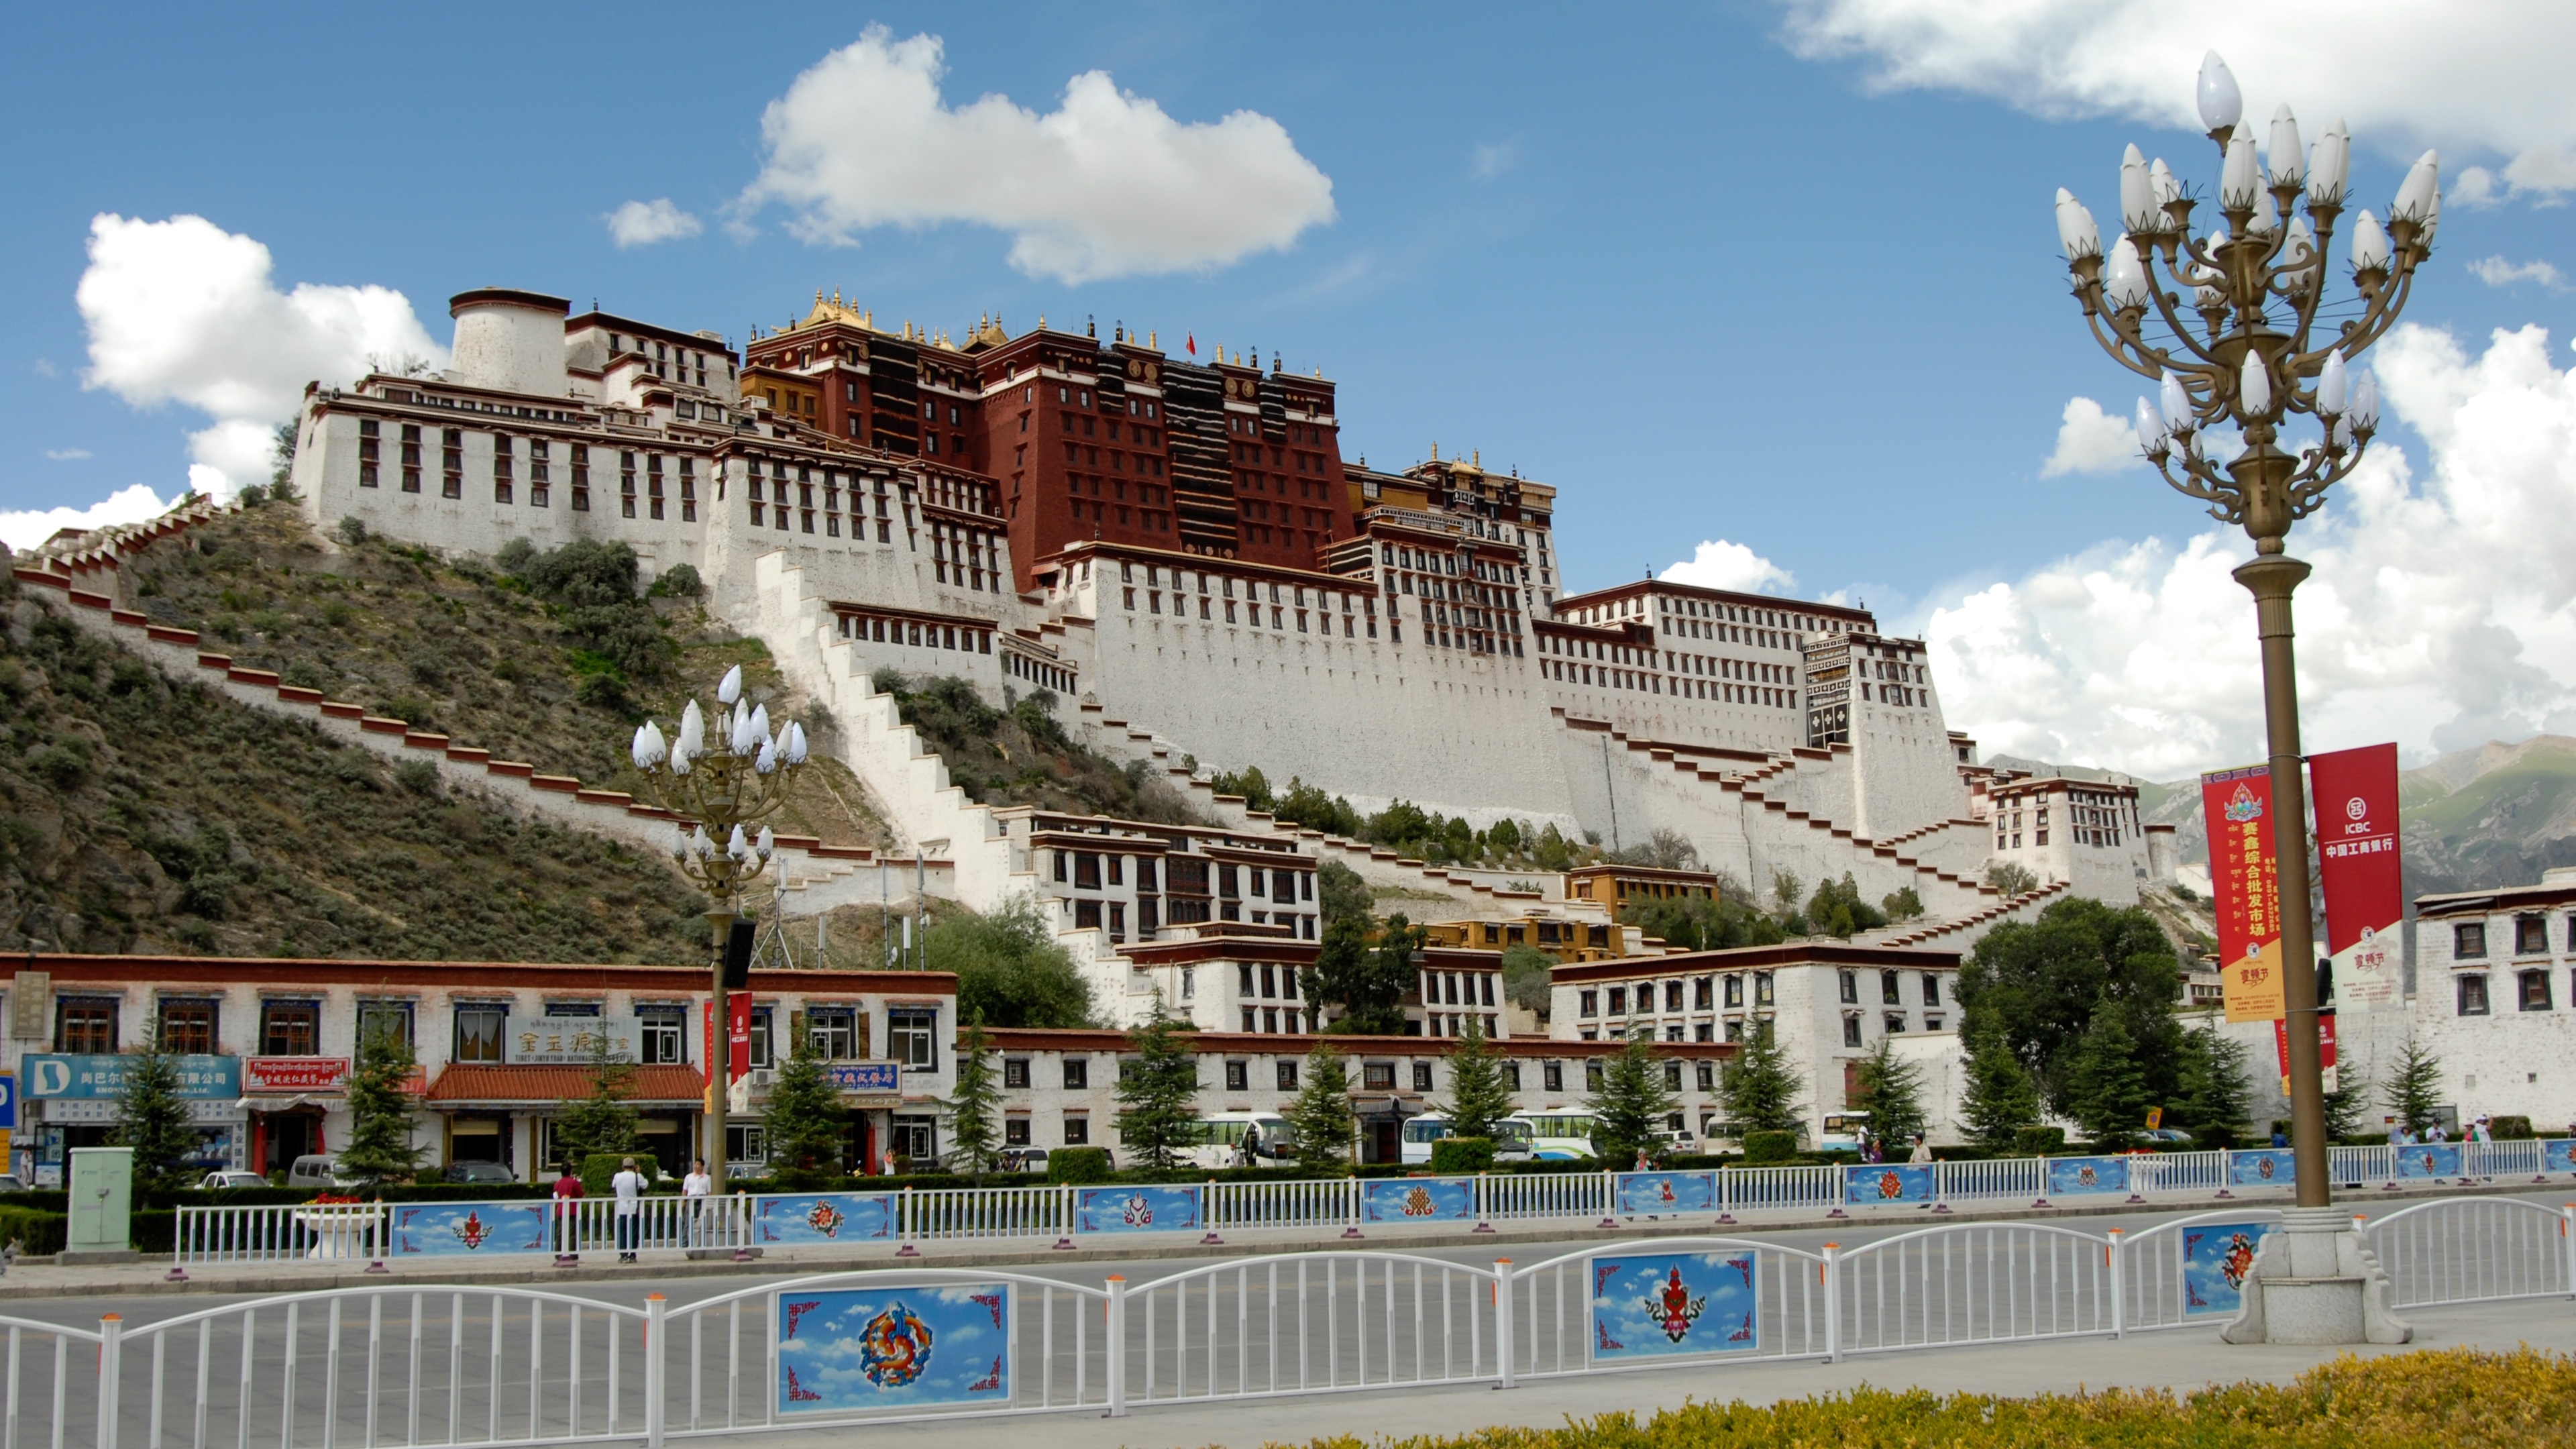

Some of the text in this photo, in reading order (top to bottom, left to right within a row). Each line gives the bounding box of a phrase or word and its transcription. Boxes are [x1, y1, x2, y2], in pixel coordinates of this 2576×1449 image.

[2345, 821, 2371, 835] ICBC
[2326, 838, 2393, 858] 中国工商银行
[2243, 822, 2265, 936] 赛鑫综合批发市场
